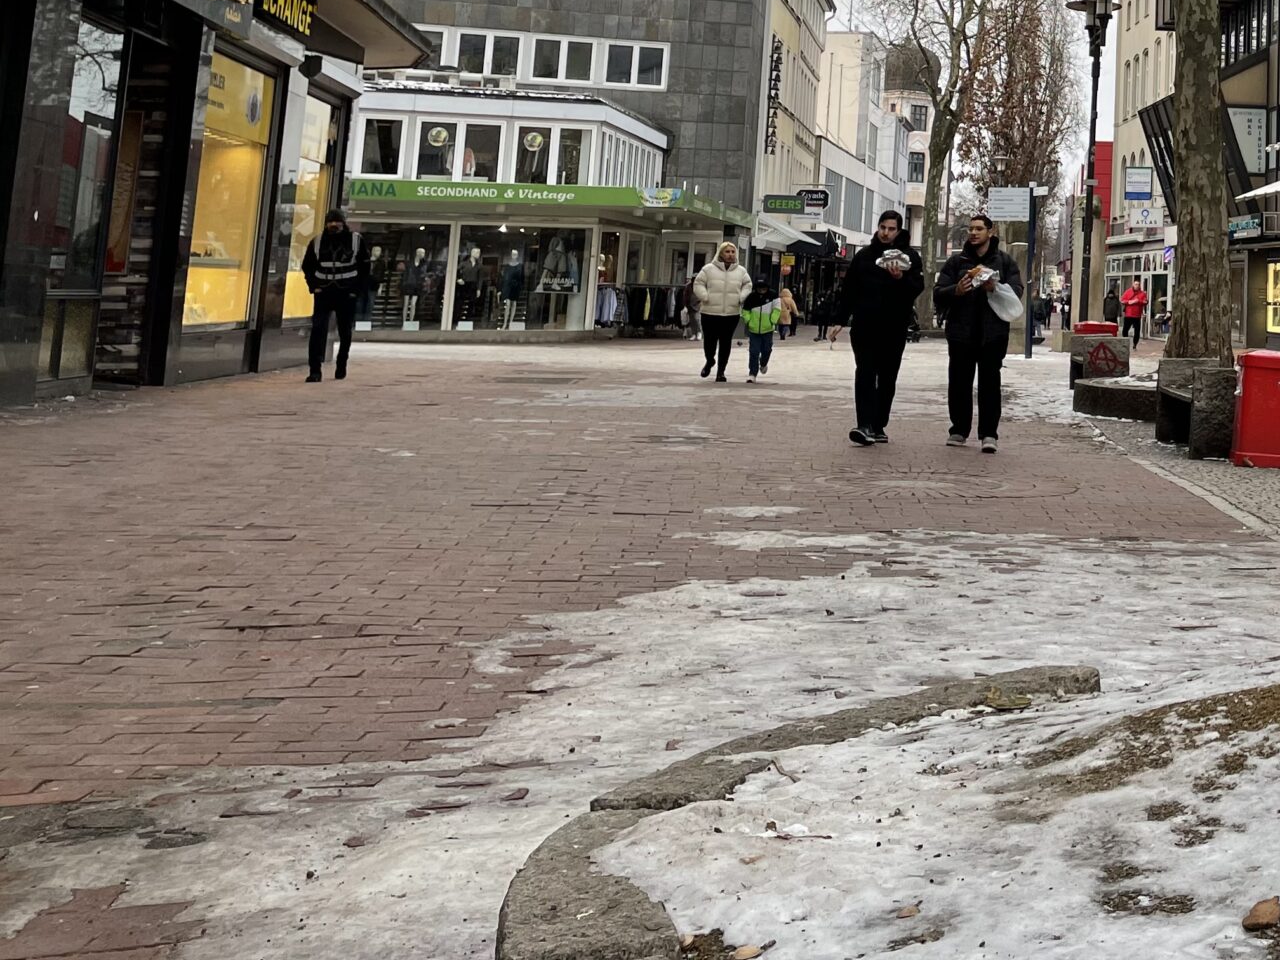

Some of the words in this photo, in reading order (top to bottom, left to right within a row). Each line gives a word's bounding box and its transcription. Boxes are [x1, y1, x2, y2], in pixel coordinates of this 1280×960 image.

[417, 186, 498, 198] SECONDHAND
[504, 188, 515, 199] &
[518, 189, 575, 202] Vintage
[767, 199, 802, 210] GEERS
